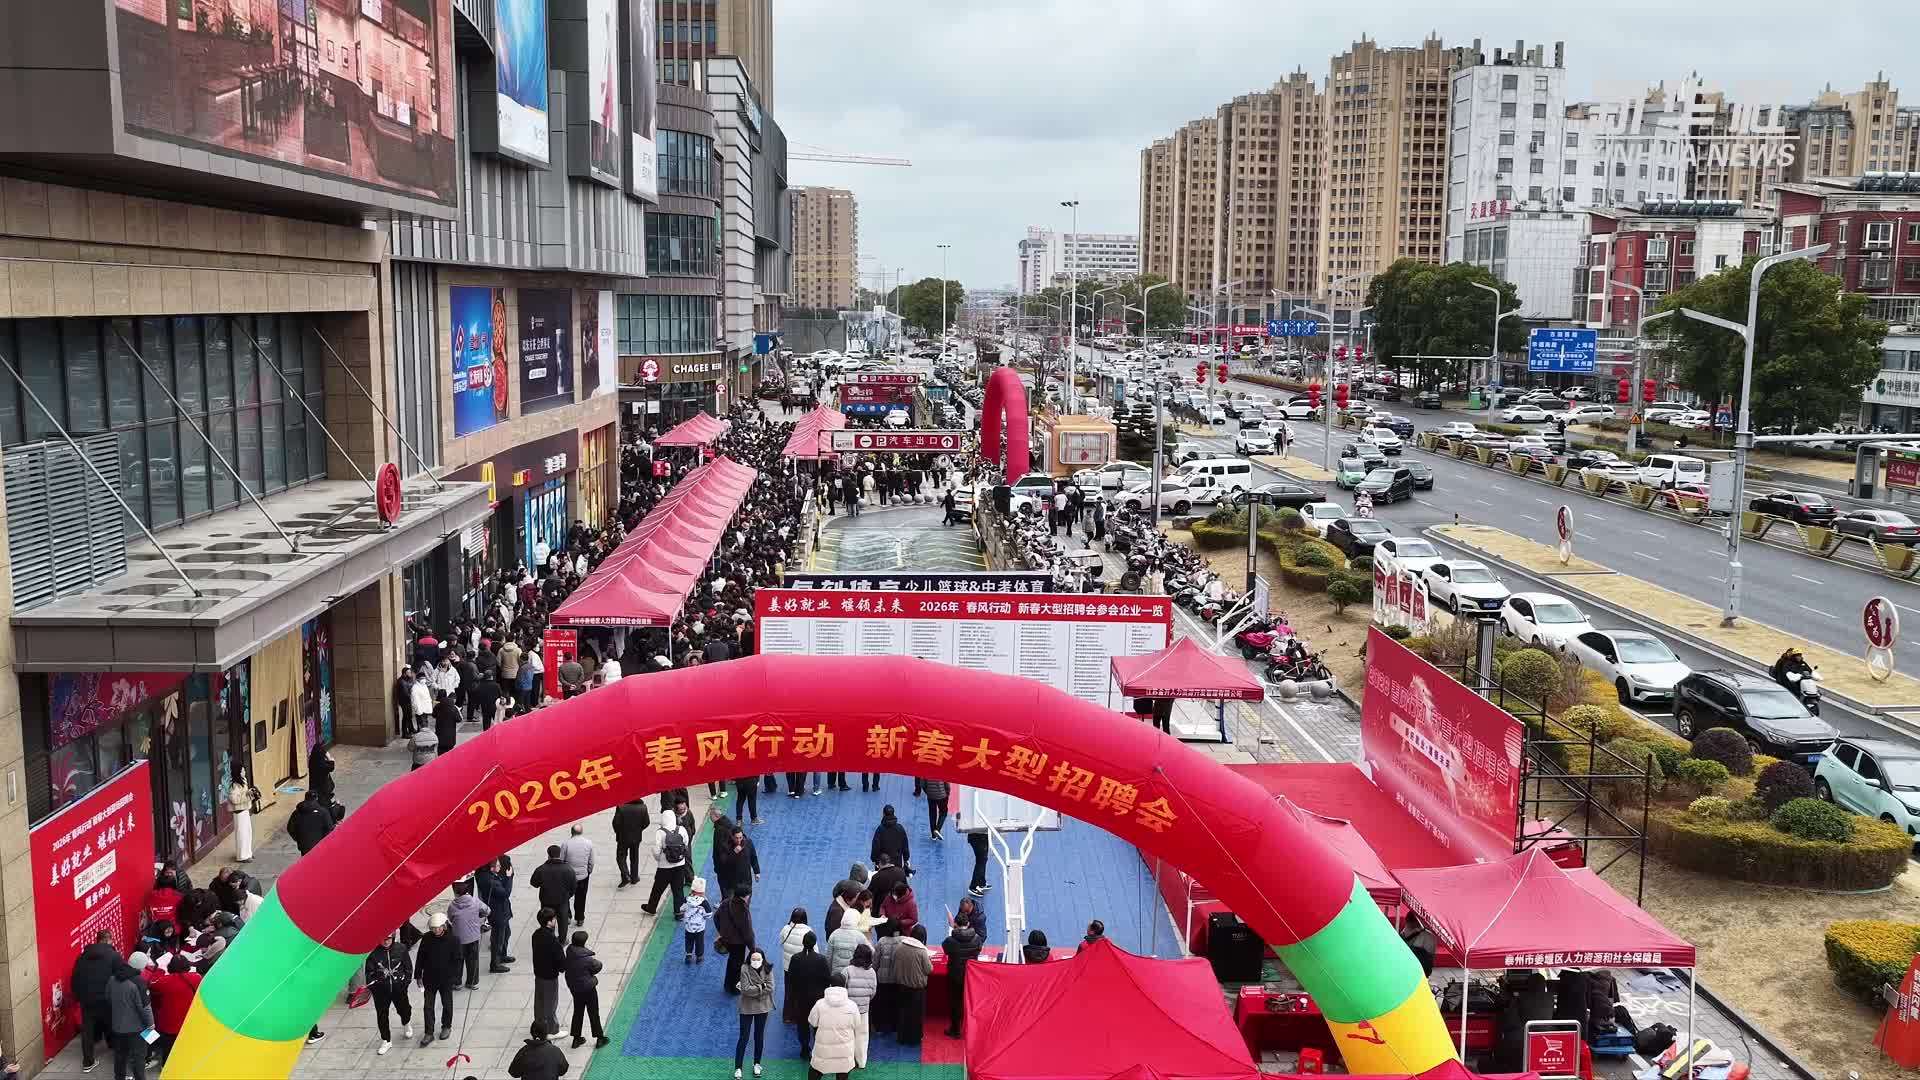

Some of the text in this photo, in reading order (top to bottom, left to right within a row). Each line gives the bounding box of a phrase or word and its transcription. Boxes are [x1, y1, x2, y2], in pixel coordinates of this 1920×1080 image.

[673, 364, 709, 374] CHAGEE
[889, 436, 938, 445] 汽车出口
[919, 601, 960, 613] 2026年
[1017, 602, 1164, 618] 新春大型招聘会参会企业一览
[467, 724, 1178, 833] 2026年 春风行动 新春大型招聘会
[1504, 952, 1662, 966] 泰州市姜堰区人力资源和社会保障局
